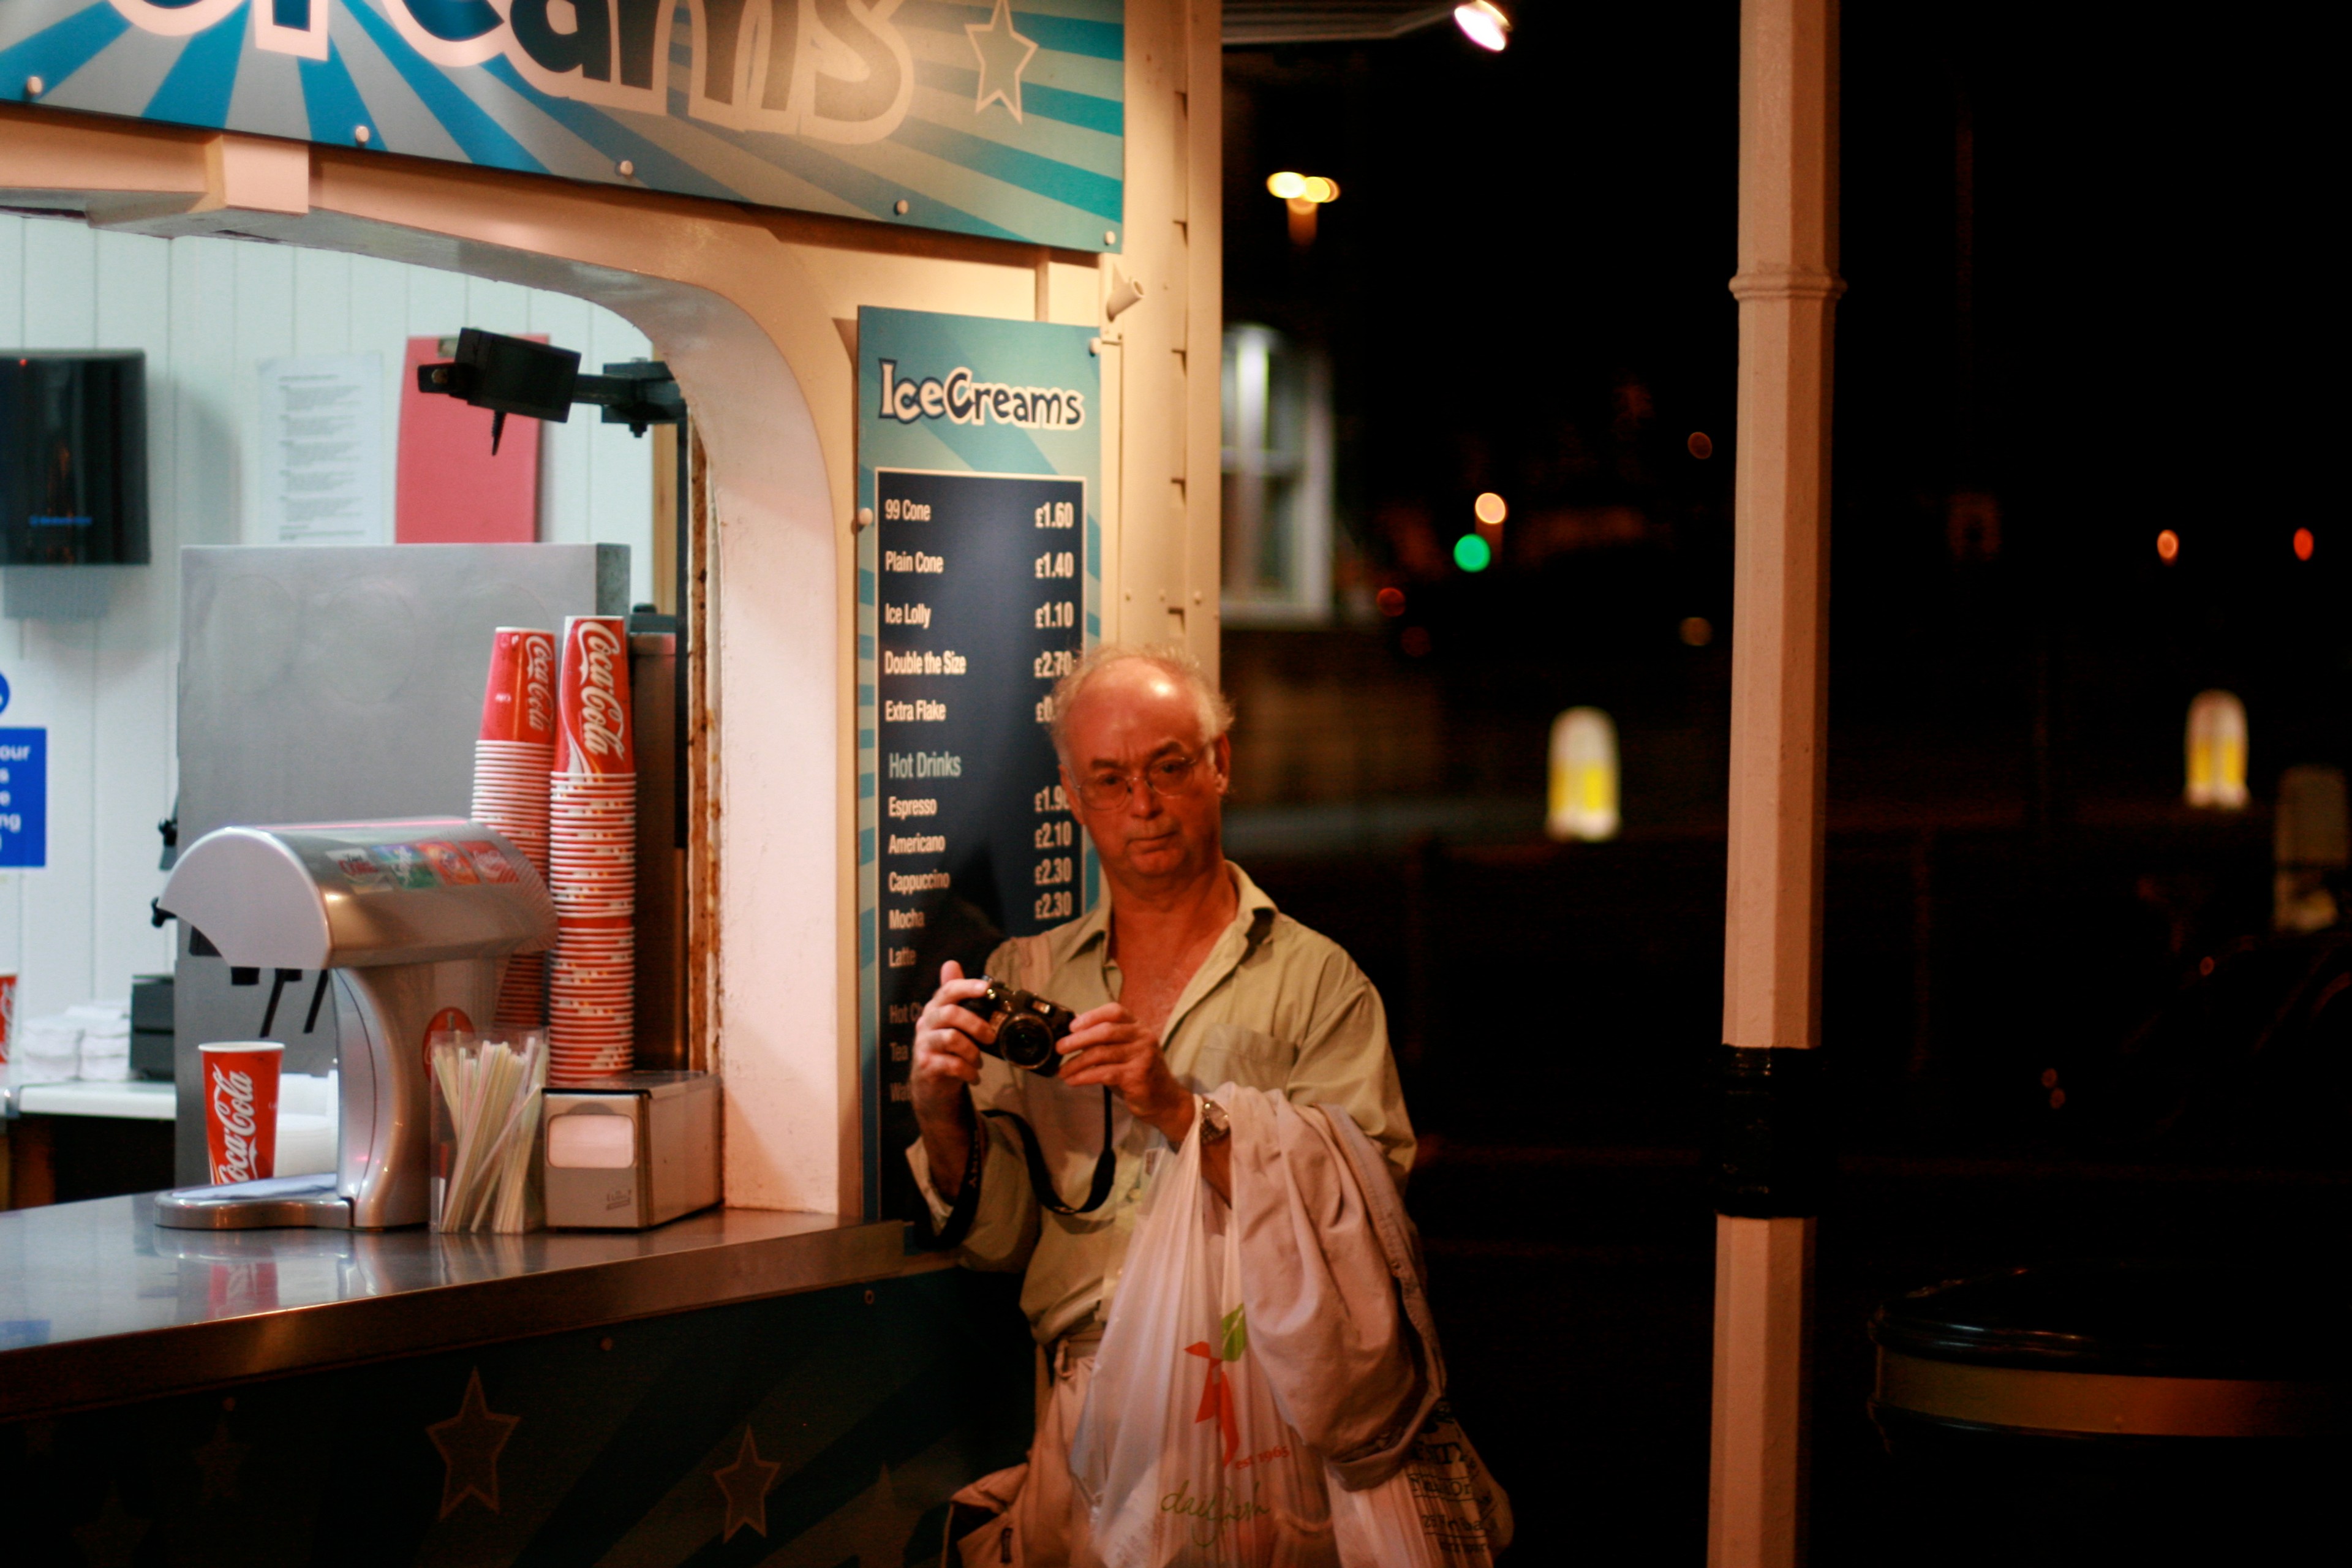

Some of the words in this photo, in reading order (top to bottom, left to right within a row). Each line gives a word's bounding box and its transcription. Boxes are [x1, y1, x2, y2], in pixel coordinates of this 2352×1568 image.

[878, 358, 1085, 431] IceCreams
[884, 499, 901, 520] 99
[902, 499, 931, 522] Cone
[1035, 502, 1074, 529] £1.60
[885, 551, 914, 572] Plain
[915, 551, 944, 574] Cone
[1035, 552, 1074, 579] £1.40
[885, 603, 902, 624] Ice
[904, 603, 932, 629] Lolly
[1035, 601, 1074, 629] £1.10
[884, 650, 923, 675] Double
[924, 650, 942, 675] the
[943, 650, 967, 675] Size
[885, 700, 914, 722] Extra
[916, 699, 947, 722] Flake
[889, 753, 914, 778] Hot
[916, 752, 962, 778] Drinks
[888, 796, 938, 820] Espresso
[888, 833, 946, 854] Americano
[1035, 821, 1072, 850] £2.10
[888, 870, 951, 896] Cappuccino
[1035, 857, 1072, 886] £2.30
[1035, 893, 1072, 919] £2.30
[888, 908, 925, 930] Mocha
[888, 948, 916, 968] Latte
[889, 1005, 908, 1024] Hot
[889, 1041, 909, 1062] Tea
